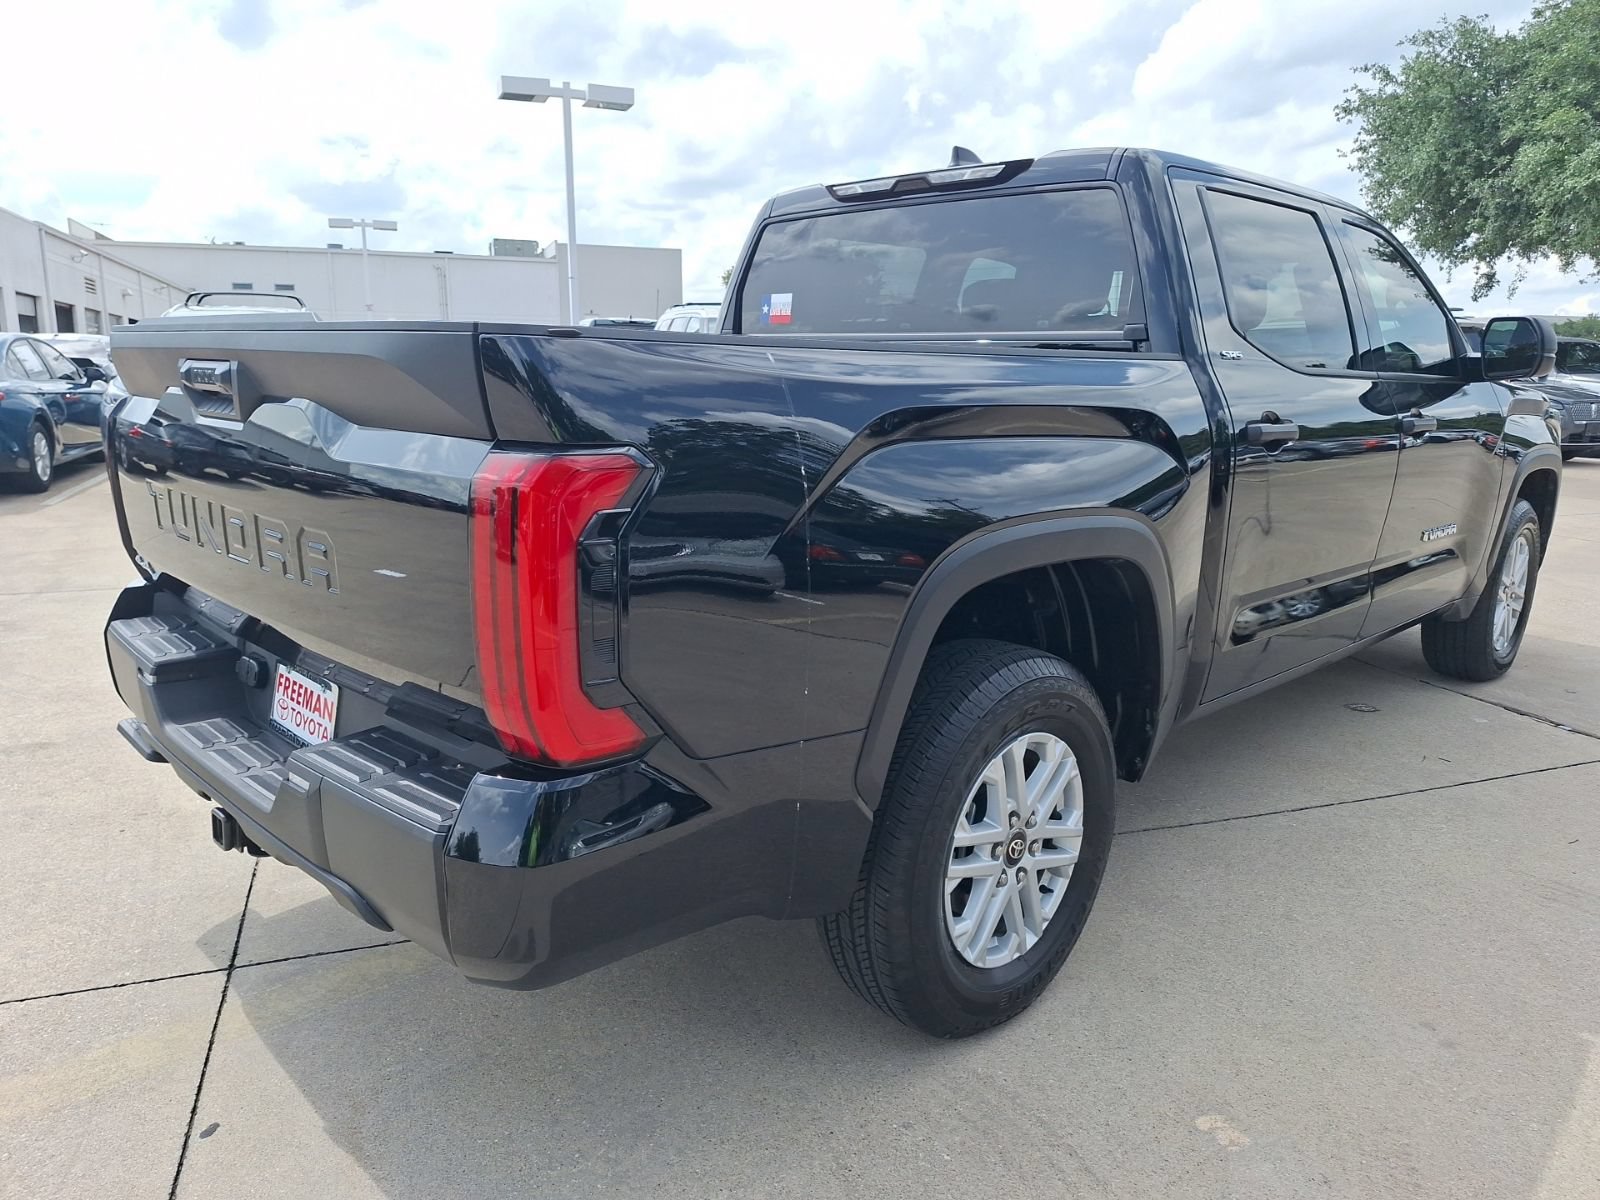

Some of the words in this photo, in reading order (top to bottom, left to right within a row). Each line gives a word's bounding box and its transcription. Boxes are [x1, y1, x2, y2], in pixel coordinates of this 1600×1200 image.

[145, 478, 341, 595] TUNDRA
[276, 672, 335, 724] FREEMAN
[289, 706, 330, 742] TOYOTA
